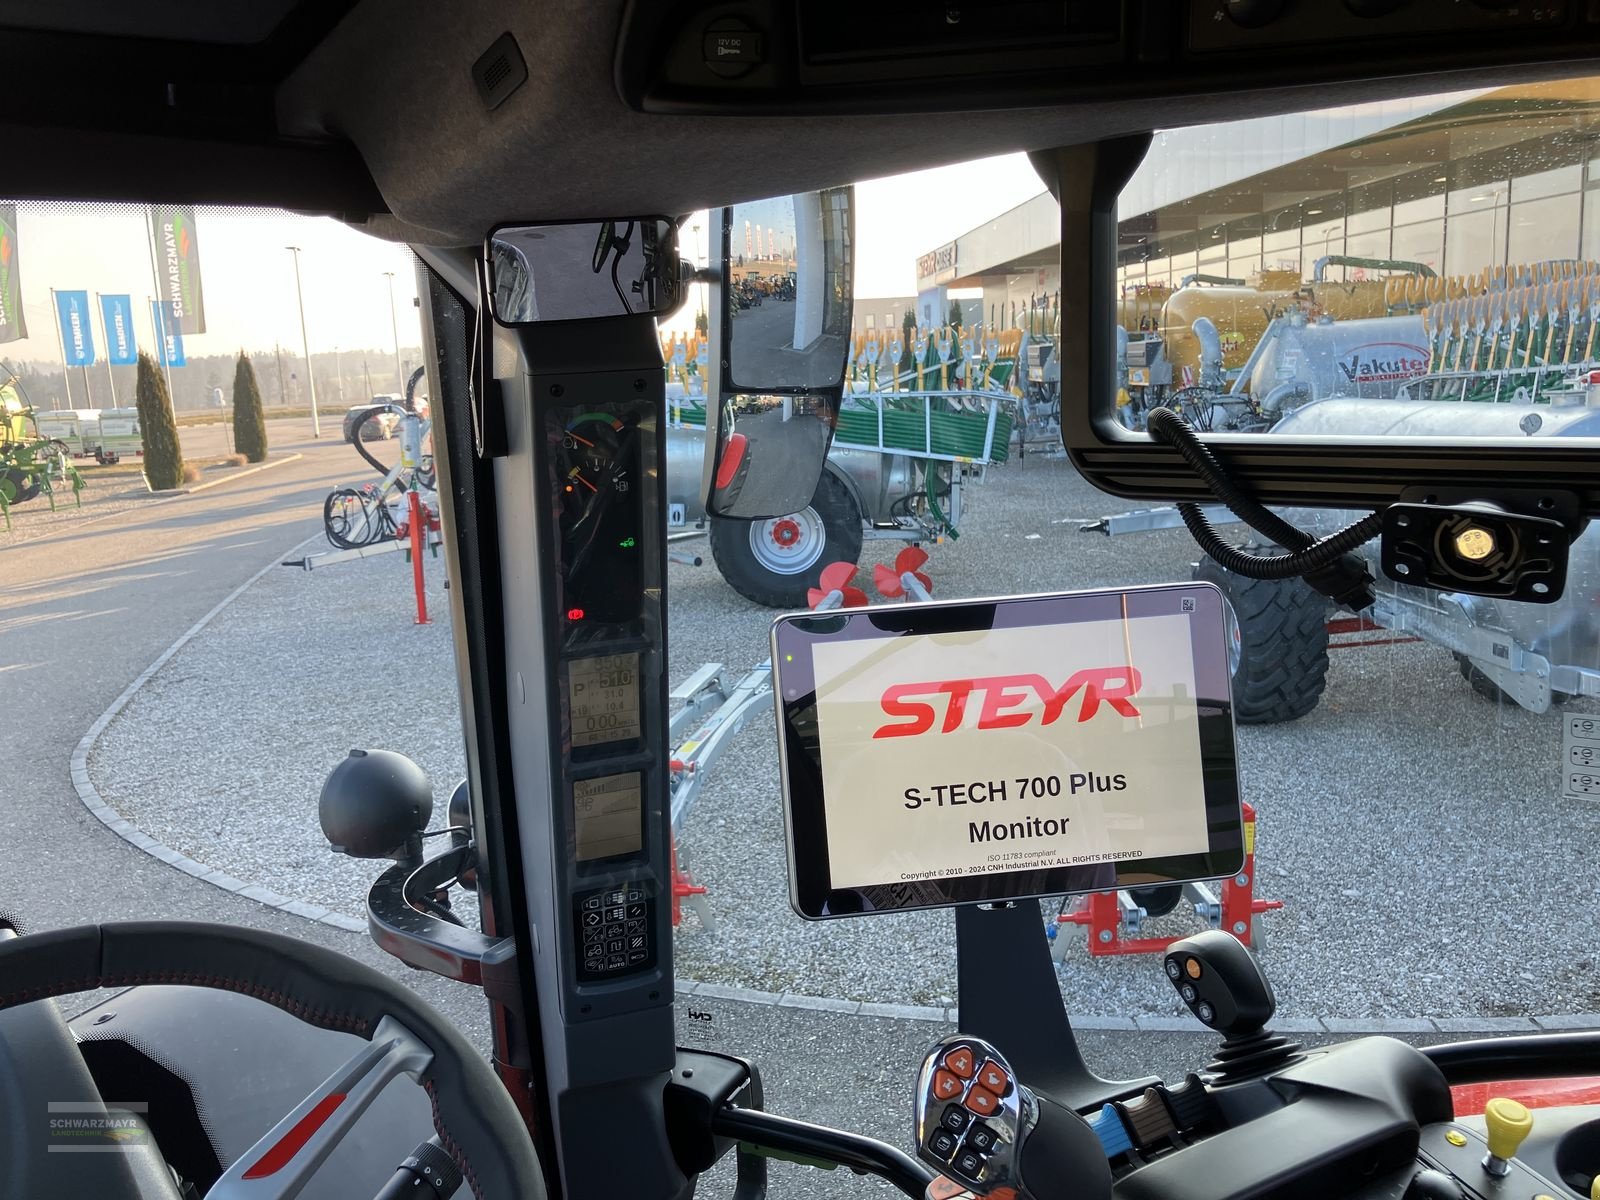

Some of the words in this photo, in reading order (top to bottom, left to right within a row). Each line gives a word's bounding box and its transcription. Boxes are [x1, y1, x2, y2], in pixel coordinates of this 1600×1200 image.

[164, 222, 184, 318] SCHWARZMAYR
[70, 312, 84, 350] LEMKEN
[114, 314, 127, 350] LEMKEN
[574, 683, 585, 697] P
[872, 665, 1143, 739] STEYR
[587, 714, 617, 730] 0.00
[903, 780, 1007, 810] S-TECH
[1015, 775, 1061, 800] 700
[1069, 771, 1128, 795] Plus
[968, 815, 1070, 843] Monitor
[900, 869, 937, 881] Copyright
[945, 867, 963, 876] 2010
[968, 865, 987, 874] 2024
[987, 863, 1004, 872] CNH
[1005, 859, 1040, 870] Industrial
[1040, 858, 1055, 867] N.V.
[1056, 856, 1071, 865] ALL
[1072, 853, 1101, 864] RIGHTS
[1102, 850, 1143, 861] RESERVED
[987, 854, 1001, 862] ISO
[1002, 852, 1023, 861] 11783
[1023, 849, 1057, 861] compliant
[609, 961, 625, 969] AUTO
